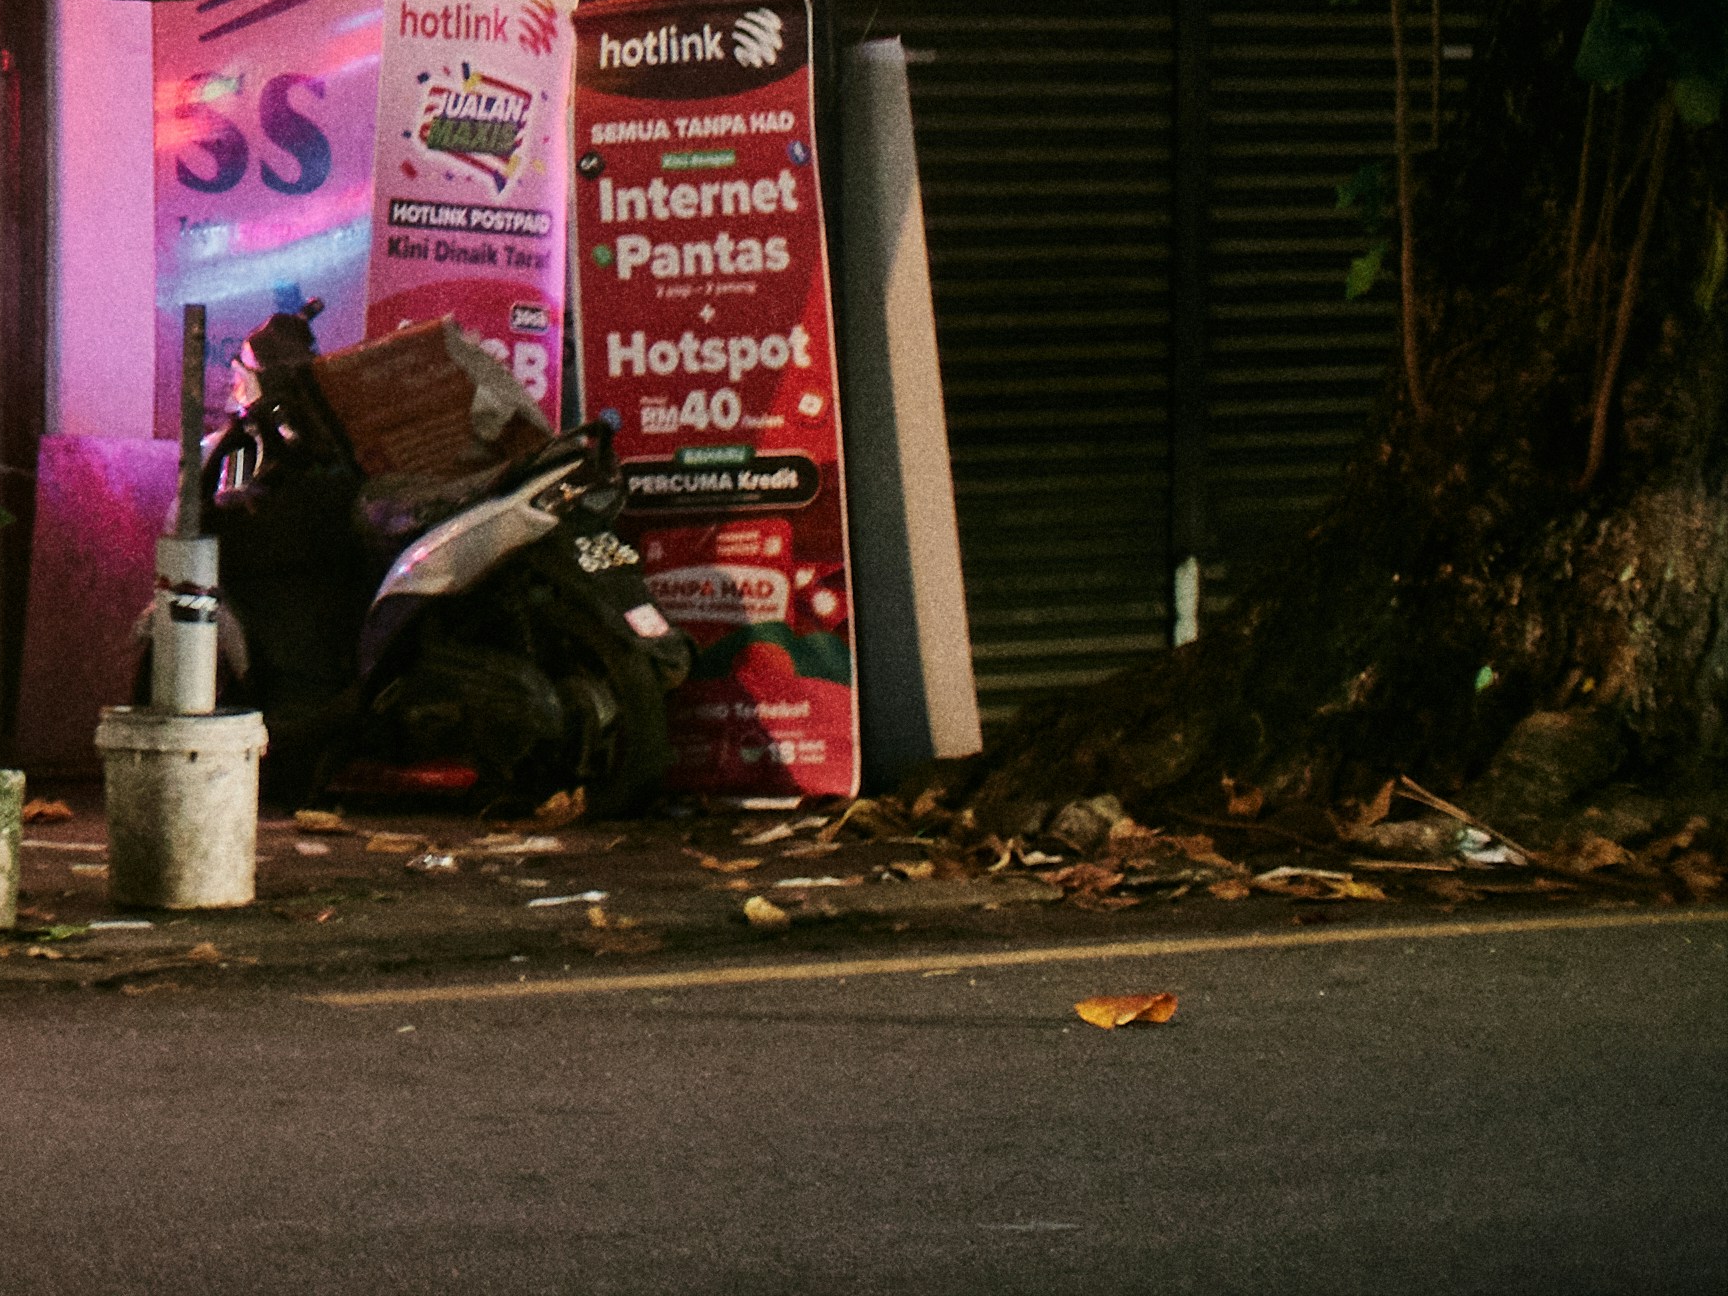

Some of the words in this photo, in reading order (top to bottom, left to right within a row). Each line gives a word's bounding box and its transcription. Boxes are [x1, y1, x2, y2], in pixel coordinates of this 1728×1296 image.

[399, 1, 508, 44] hotlink
[599, 23, 726, 70] hotlink
[591, 119, 670, 145] SEMUA
[674, 114, 747, 139] TANPA
[750, 110, 796, 135] HAD
[393, 203, 468, 226] HOTLINK
[599, 169, 799, 223] Internet
[387, 236, 429, 259] Kini
[616, 231, 790, 281] Pantas
[607, 324, 812, 383] Hotspot
[628, 471, 734, 495] PERCUMA
